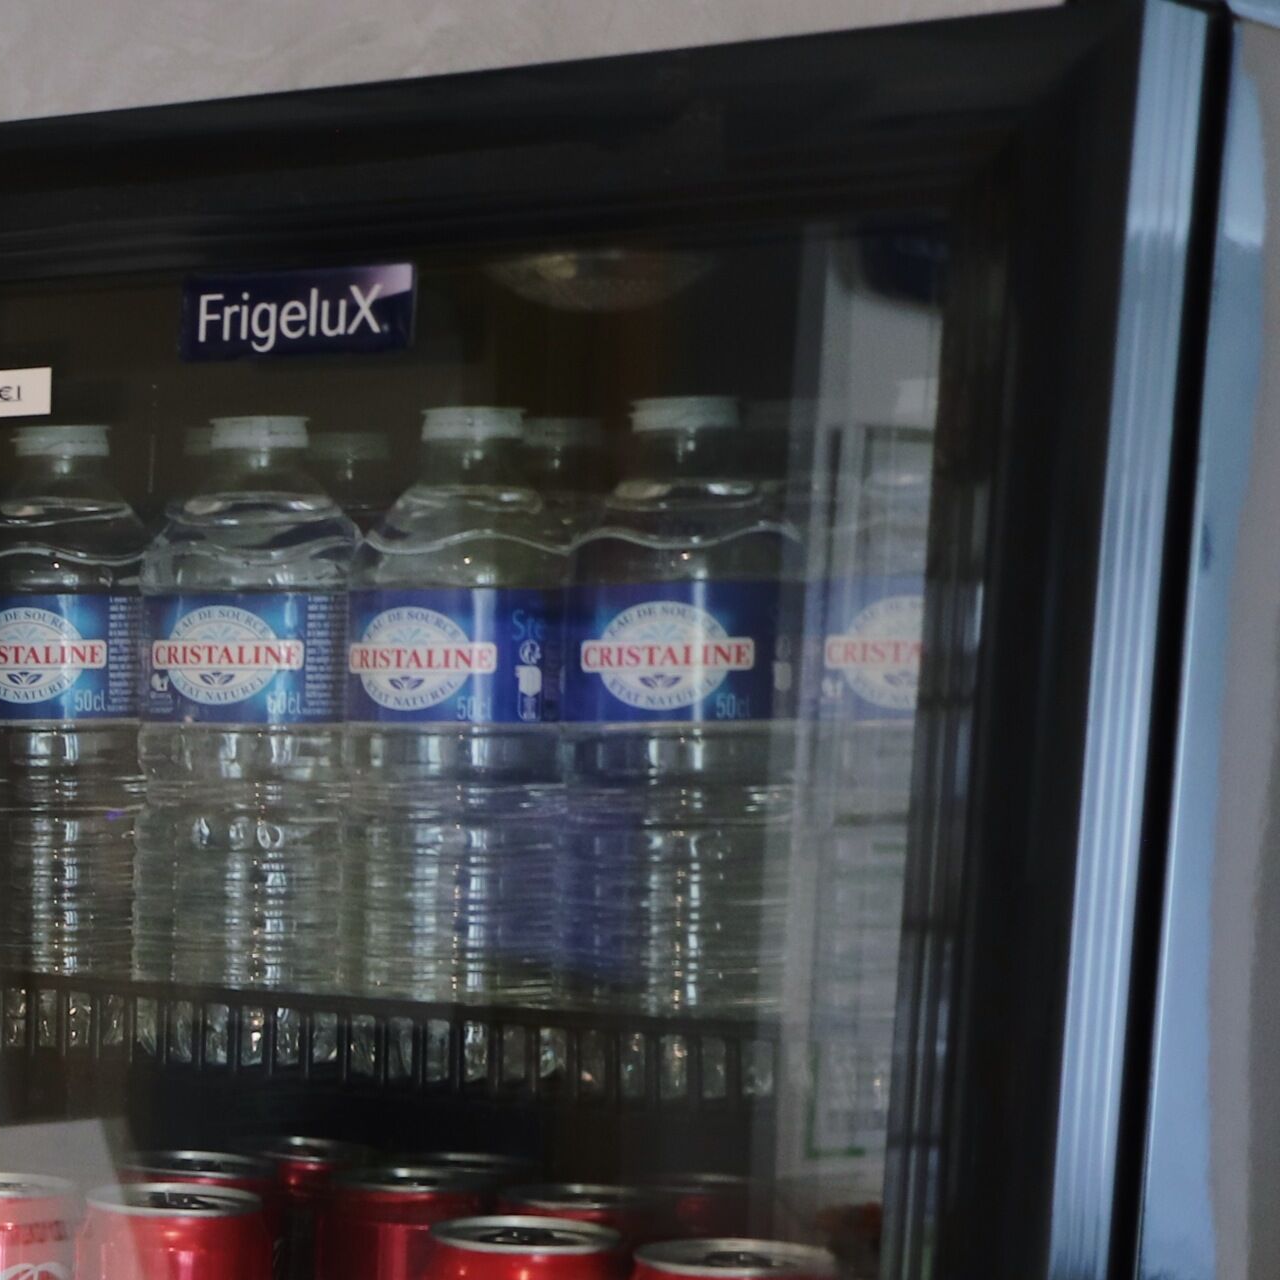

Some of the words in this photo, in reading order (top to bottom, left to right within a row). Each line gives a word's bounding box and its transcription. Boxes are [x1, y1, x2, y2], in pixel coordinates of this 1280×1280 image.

[198, 283, 382, 352] FrigeluX
[155, 645, 300, 665] CRISTALINE
[351, 649, 492, 669] CRISTALINE
[583, 644, 751, 668] CRISTALINE
[75, 690, 107, 712] 50cl
